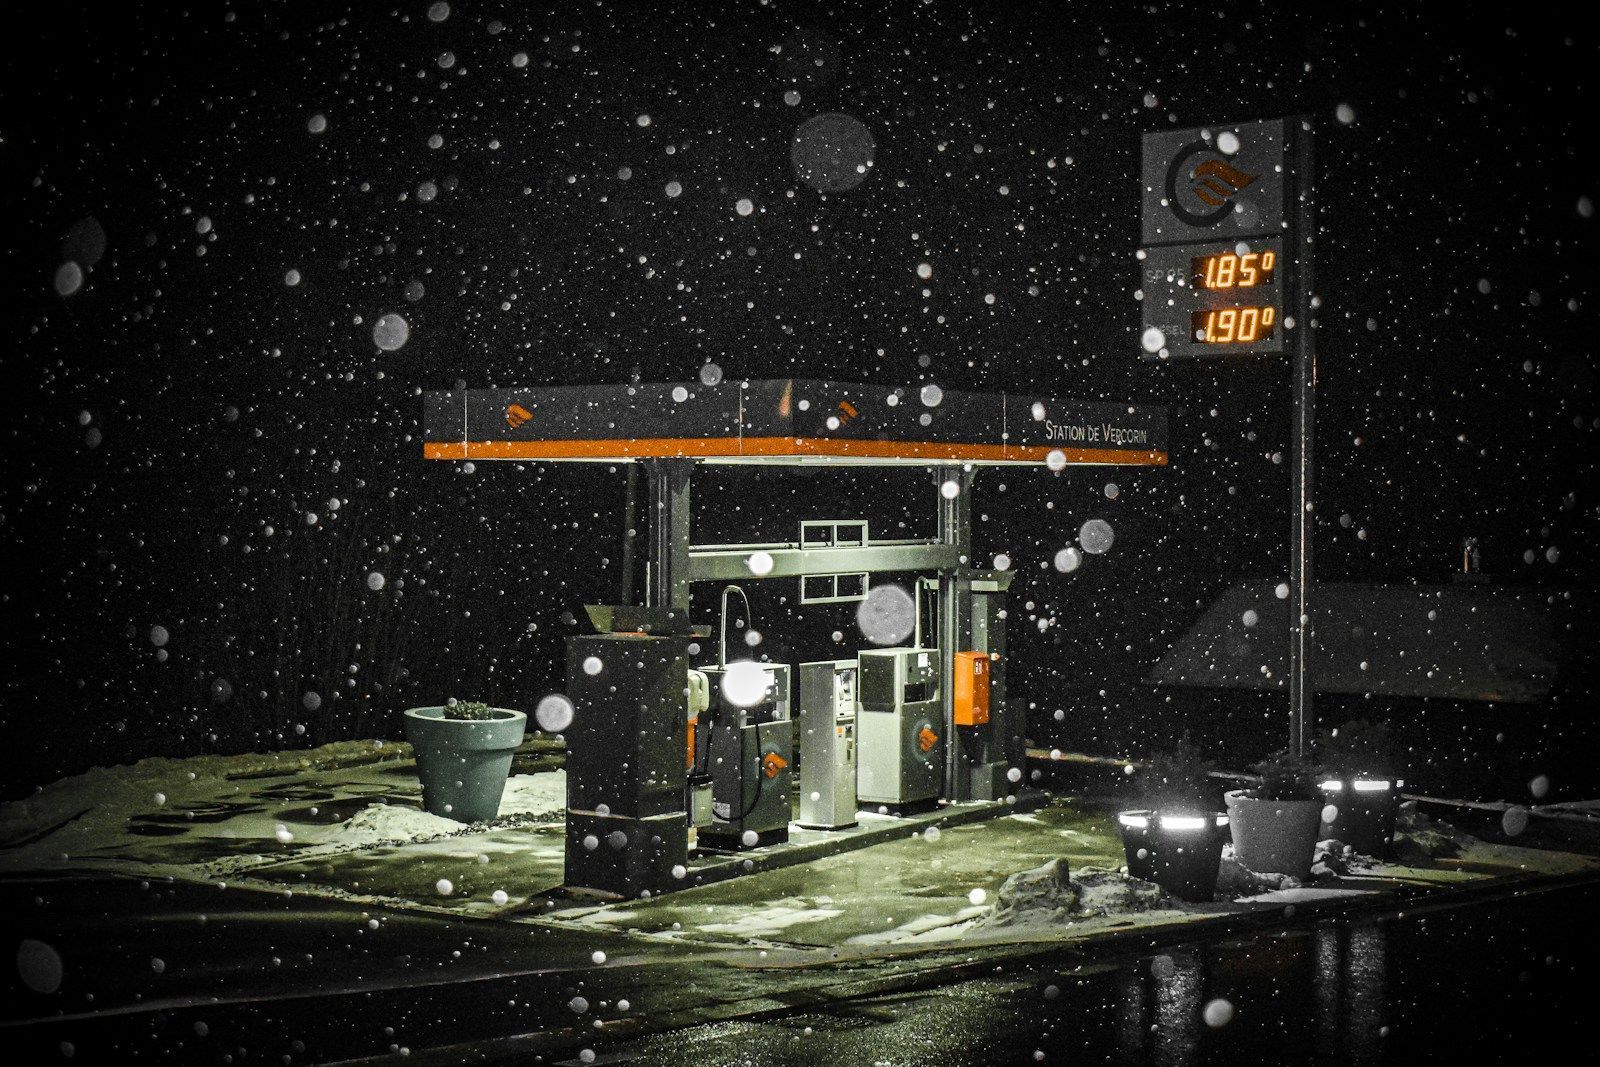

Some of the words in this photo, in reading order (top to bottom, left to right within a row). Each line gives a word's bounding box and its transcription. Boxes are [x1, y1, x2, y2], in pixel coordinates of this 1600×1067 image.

[1146, 269, 1164, 283] SP
[1145, 324, 1185, 336] ESEL
[1045, 419, 1085, 441] STATION
[1087, 424, 1100, 442] DE
[1102, 422, 1147, 444] VERCORIN
